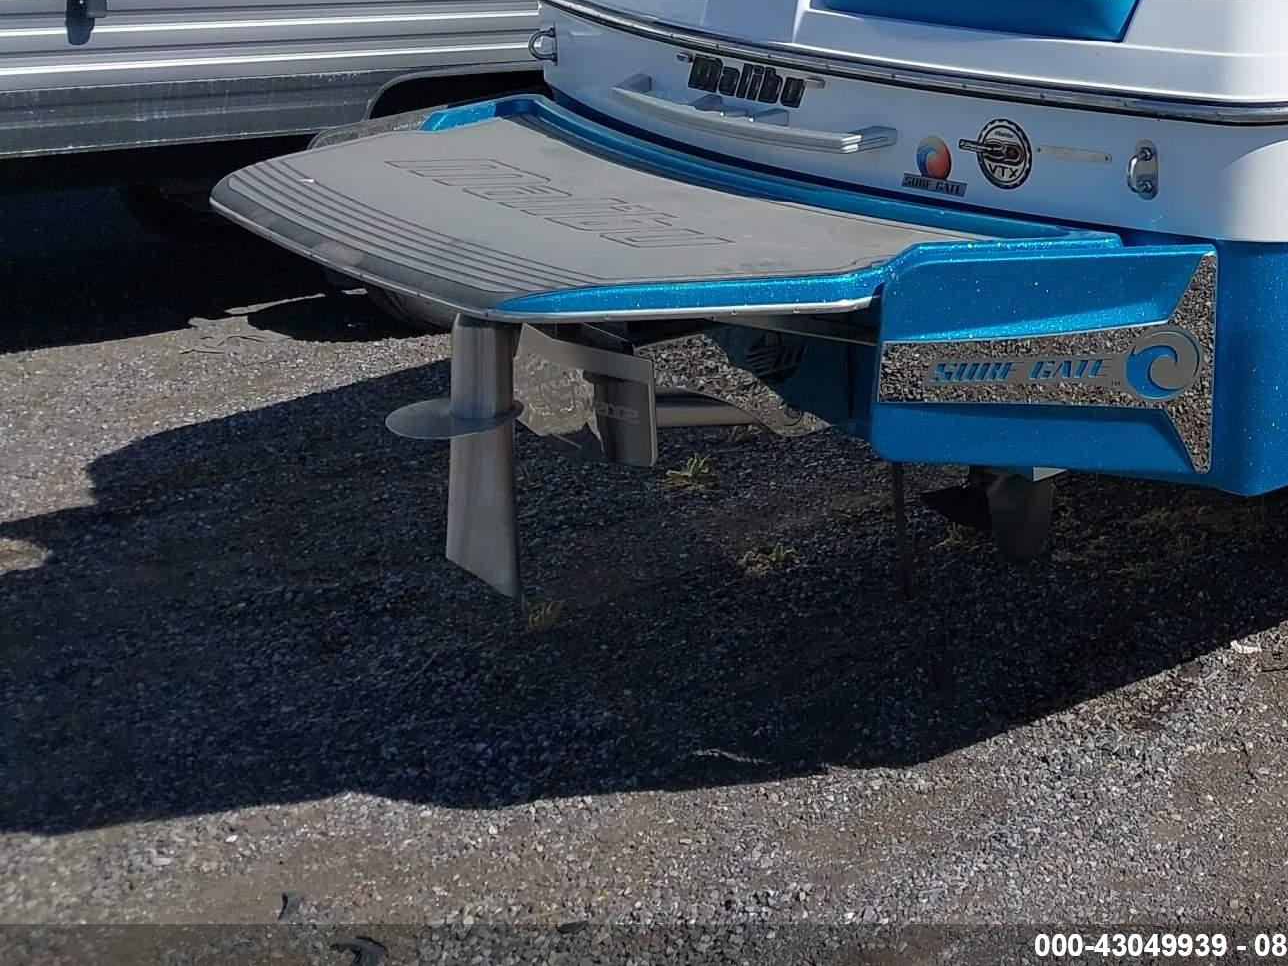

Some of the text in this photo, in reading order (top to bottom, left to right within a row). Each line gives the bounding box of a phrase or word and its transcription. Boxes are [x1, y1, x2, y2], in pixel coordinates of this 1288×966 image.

[687, 53, 807, 109] Malibu
[988, 163, 1019, 179] VTX
[904, 175, 964, 195] SURF GATE
[930, 361, 1024, 383] SURF
[1029, 358, 1113, 380] GATE
